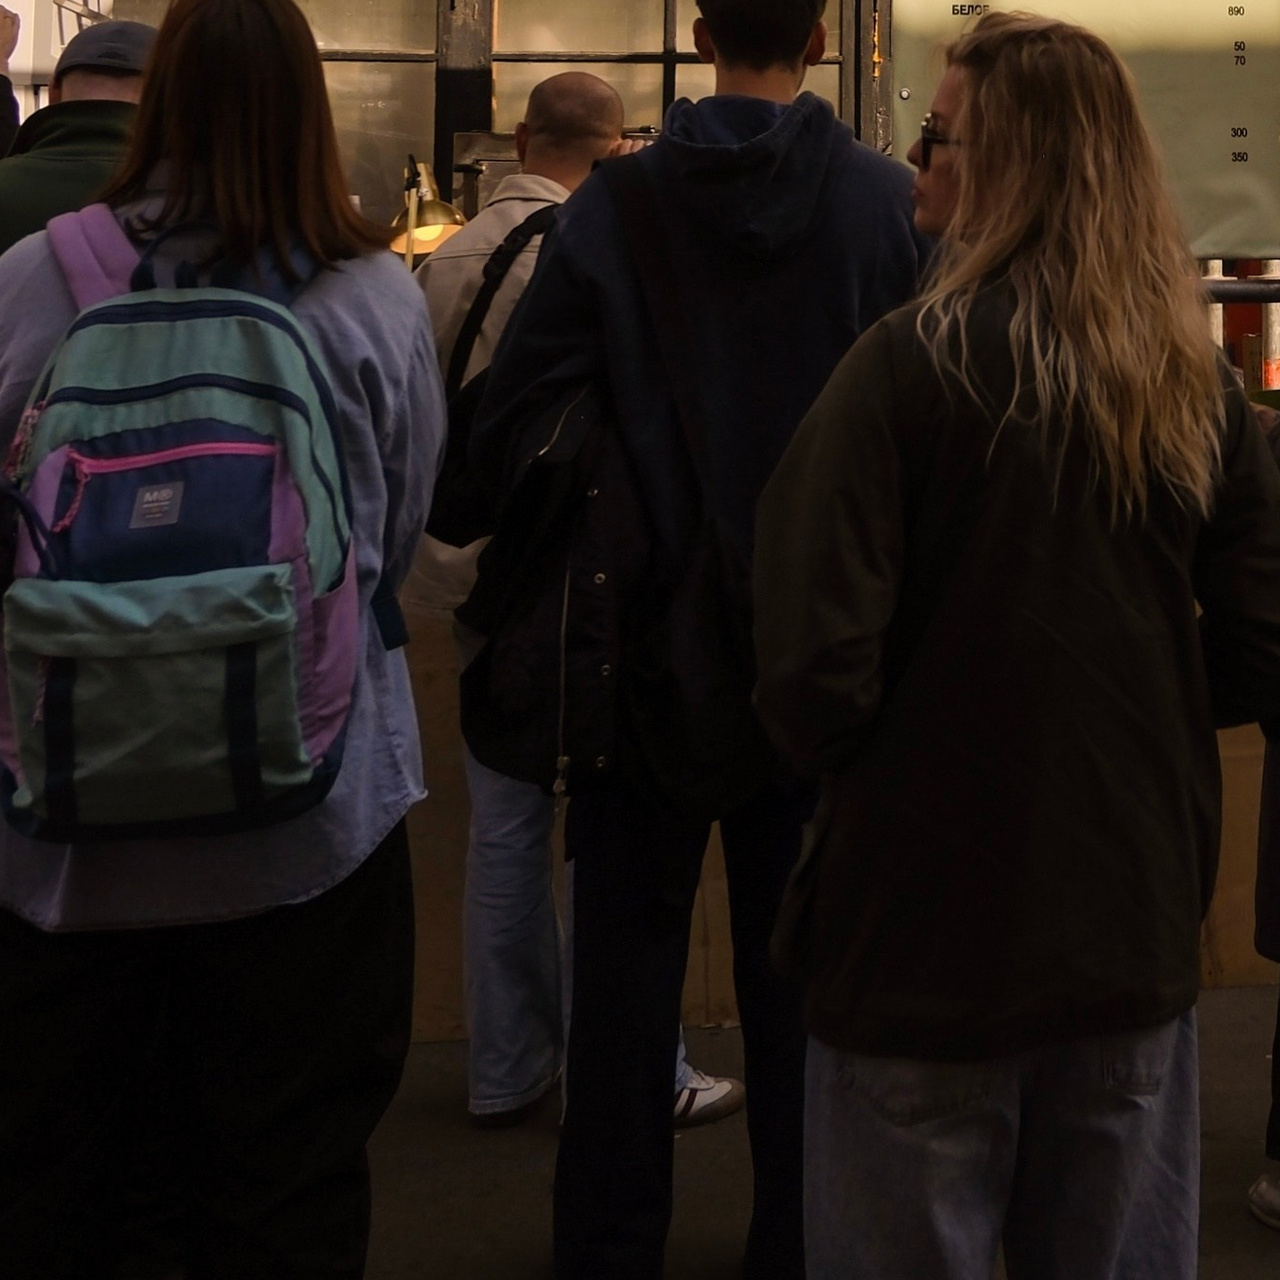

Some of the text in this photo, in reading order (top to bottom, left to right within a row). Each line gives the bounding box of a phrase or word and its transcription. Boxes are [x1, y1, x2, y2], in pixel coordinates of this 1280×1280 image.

[1227, 5, 1245, 17] 890
[1233, 40, 1246, 52] 50
[1233, 54, 1246, 66] 70
[1230, 127, 1248, 138] 300
[1231, 151, 1249, 163] 350
